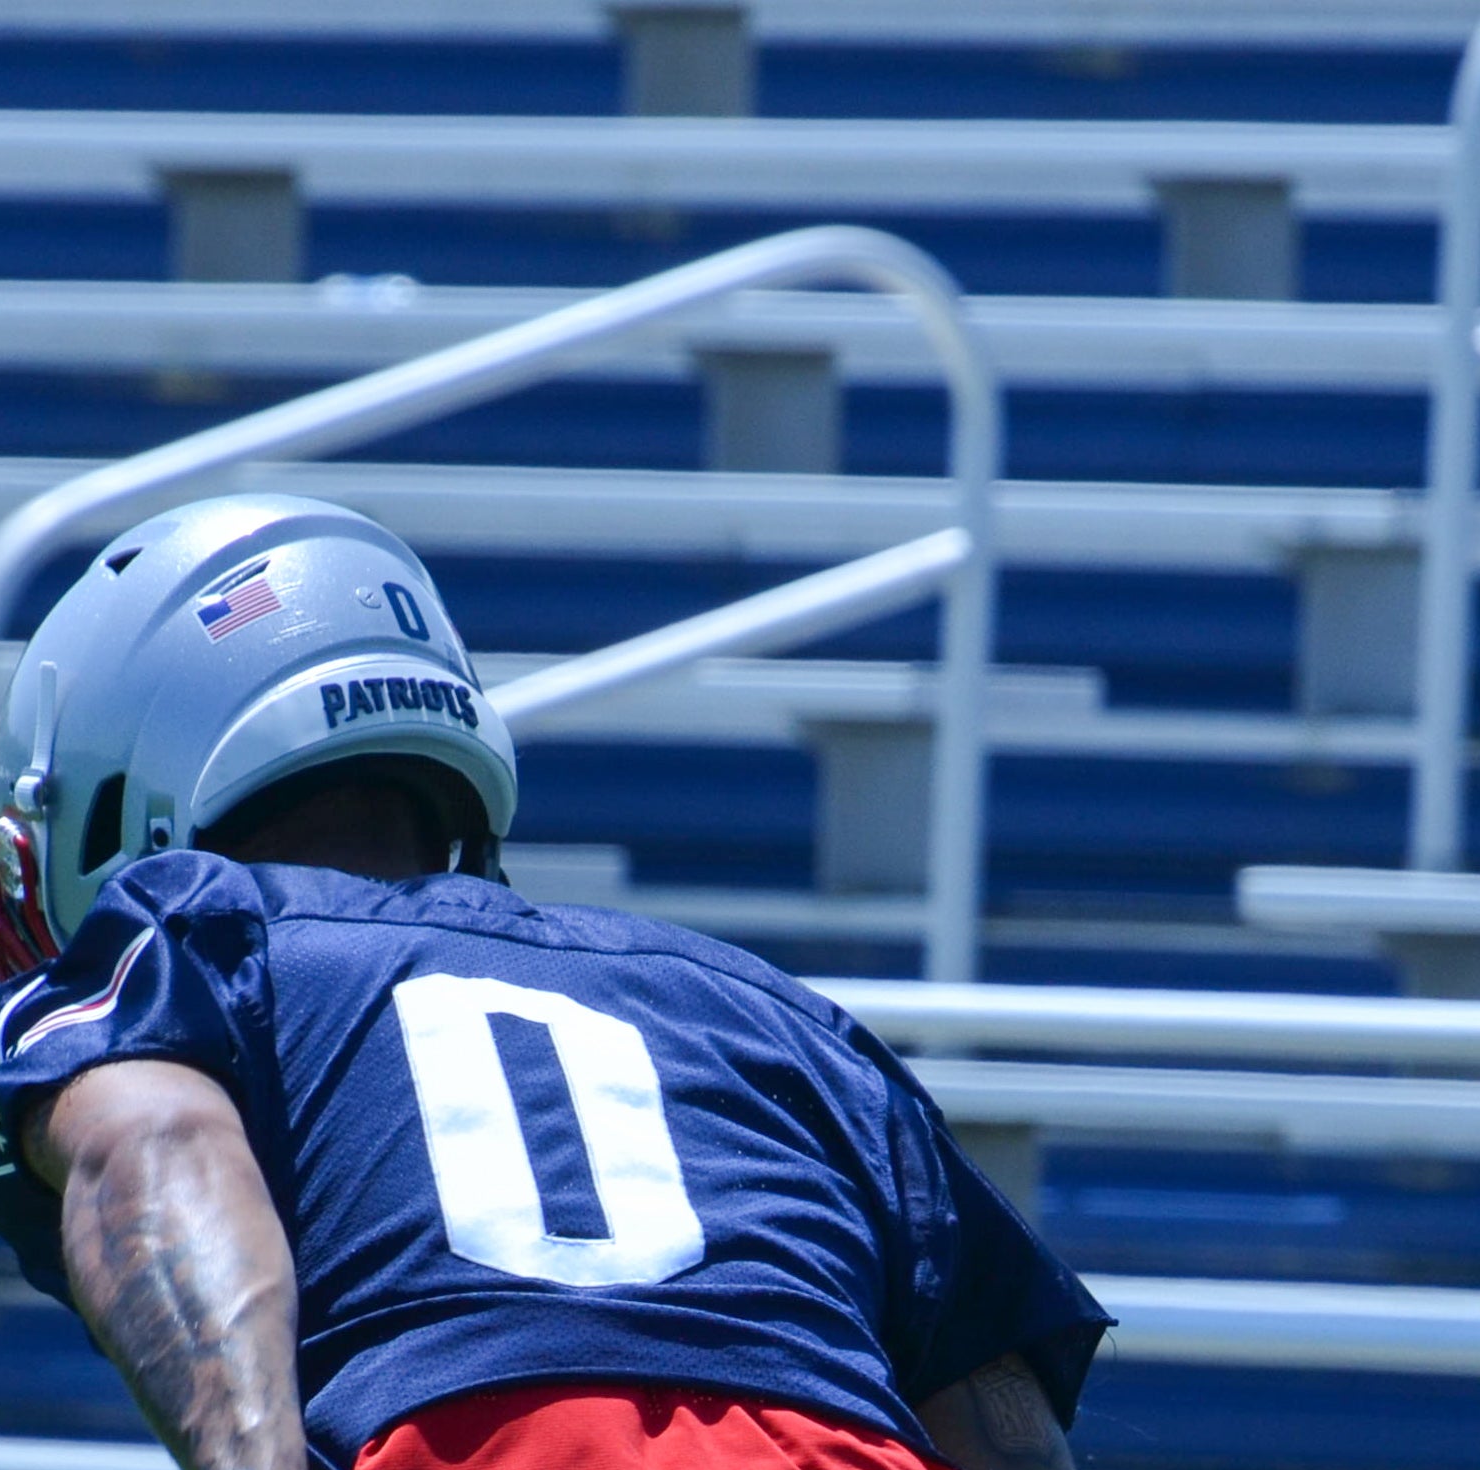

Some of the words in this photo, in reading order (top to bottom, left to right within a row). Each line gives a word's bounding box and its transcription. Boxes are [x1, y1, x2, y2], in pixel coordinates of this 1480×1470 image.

[382, 581, 430, 641] 0
[320, 677, 479, 729] PATRIOTS
[392, 972, 706, 1288] 0
